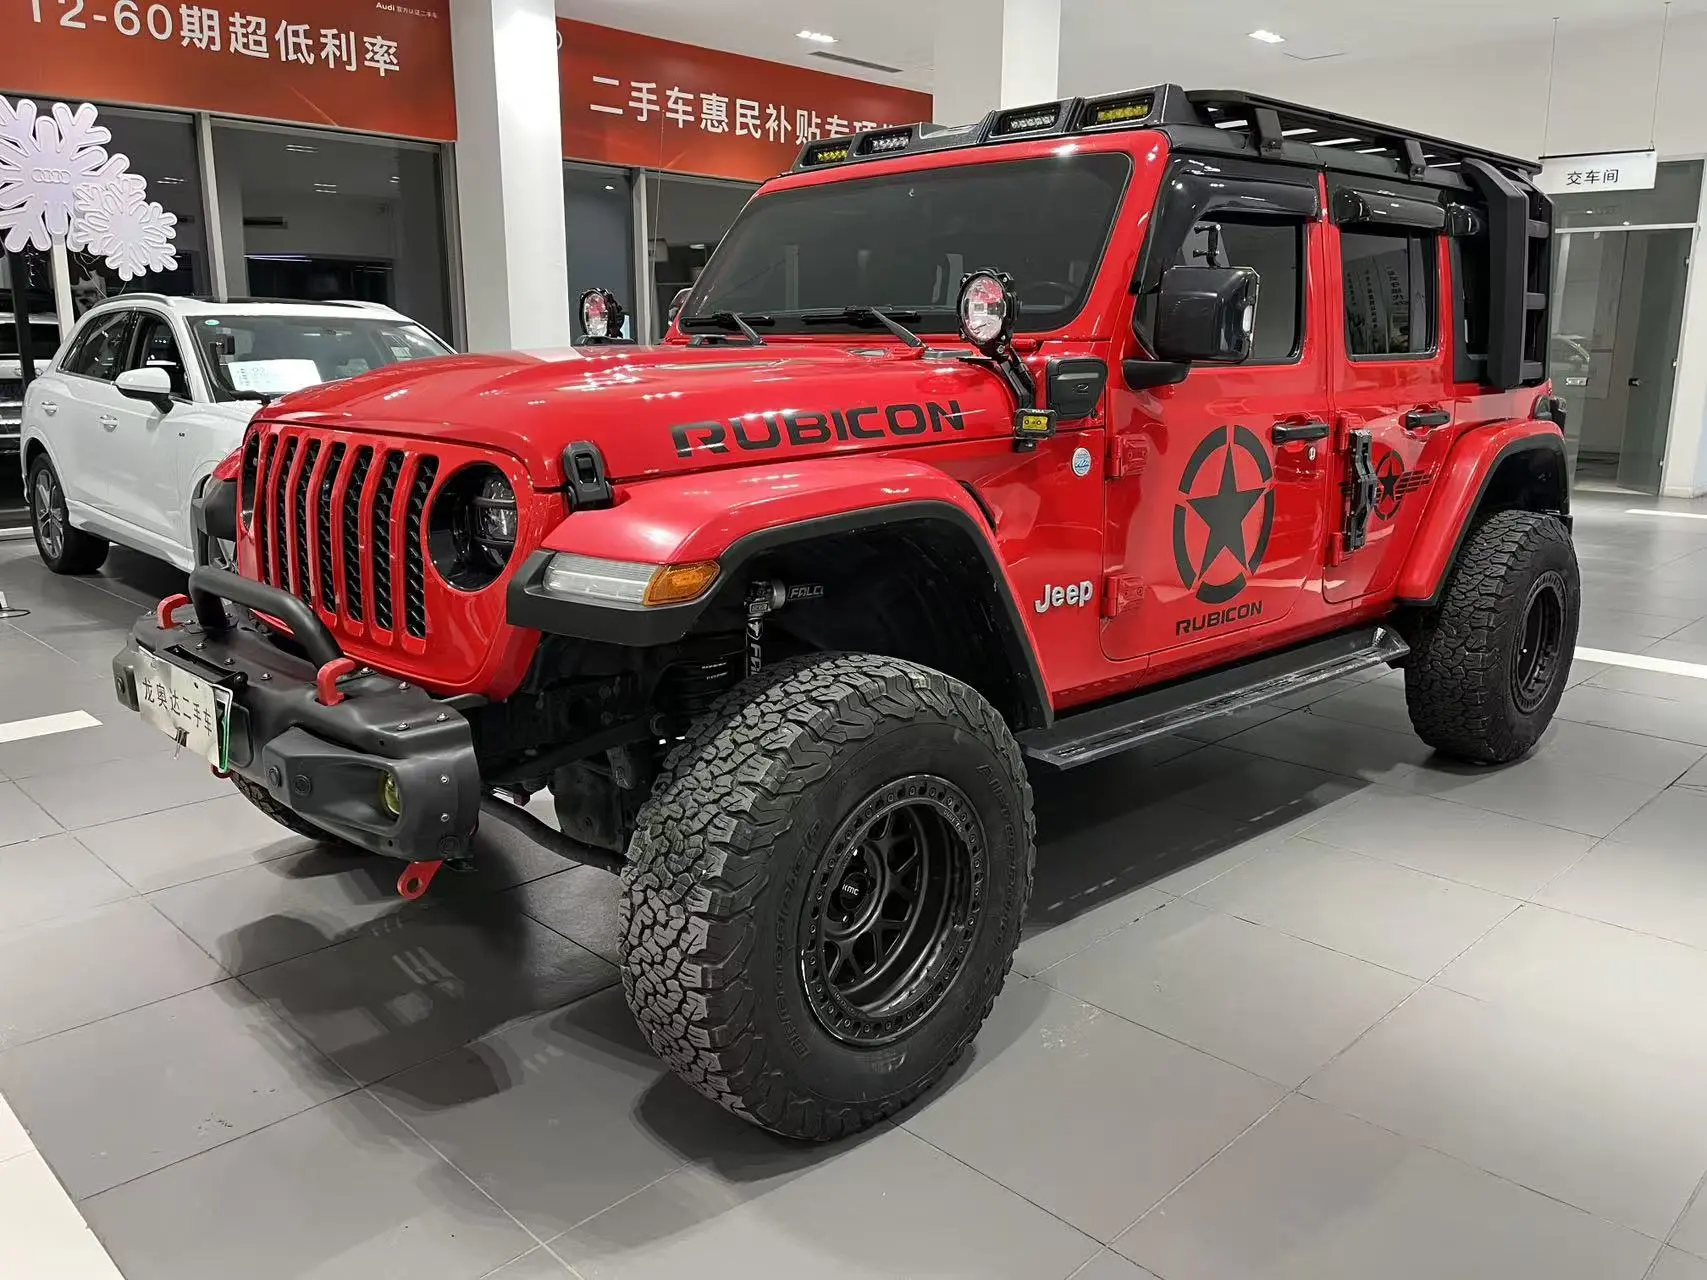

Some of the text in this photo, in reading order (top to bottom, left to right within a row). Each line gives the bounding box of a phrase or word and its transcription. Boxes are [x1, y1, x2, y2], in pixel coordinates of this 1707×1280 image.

[376, 2, 395, 12] Audi
[31, 0, 400, 77] 12-60期超低利率
[590, 75, 894, 146] 二手车惠民补贴专
[1566, 168, 1619, 186] 交车间
[669, 399, 965, 458] RUBICON
[1034, 580, 1094, 614] Jeep
[1175, 600, 1263, 636] RUBICON
[142, 677, 213, 737] 龙奥达二手车
